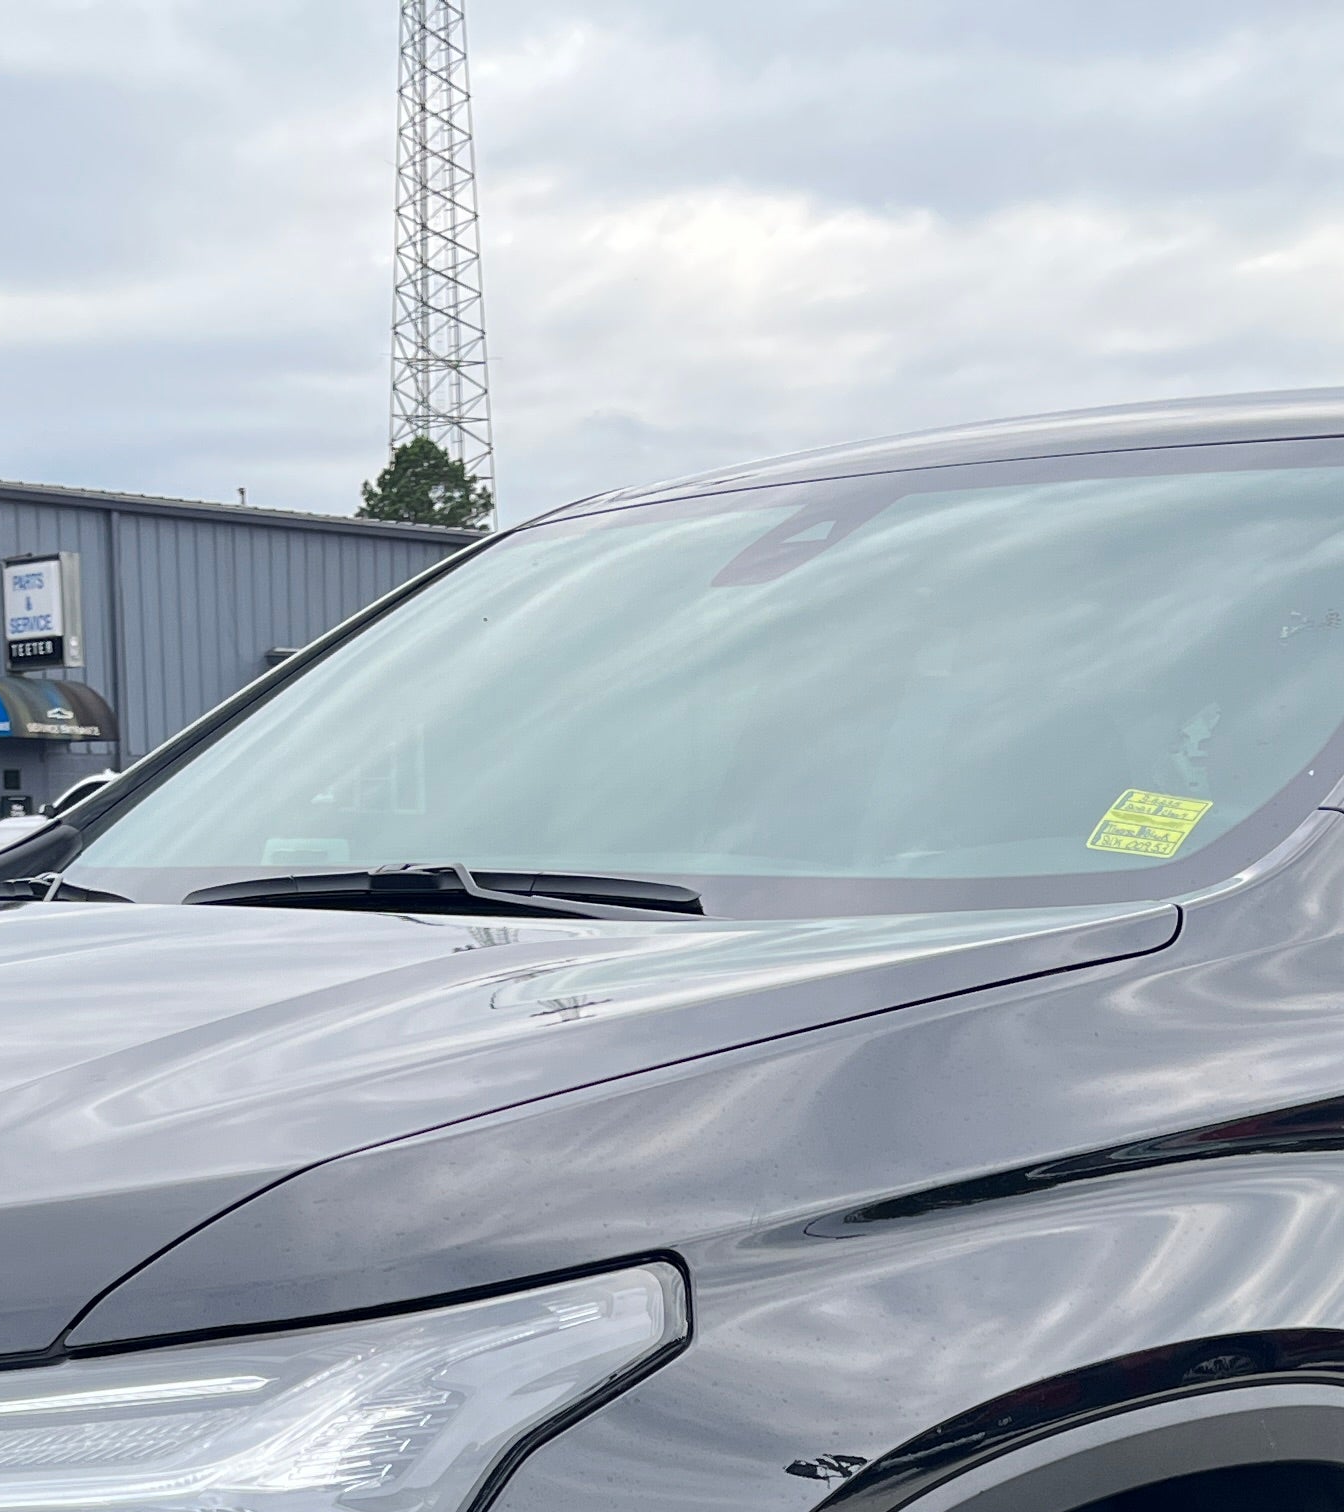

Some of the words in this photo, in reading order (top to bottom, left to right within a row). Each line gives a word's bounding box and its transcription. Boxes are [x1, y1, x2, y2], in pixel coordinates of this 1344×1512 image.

[12, 571, 45, 592] PARTS
[9, 613, 53, 635] SERVICE
[10, 640, 54, 658] TEETER
